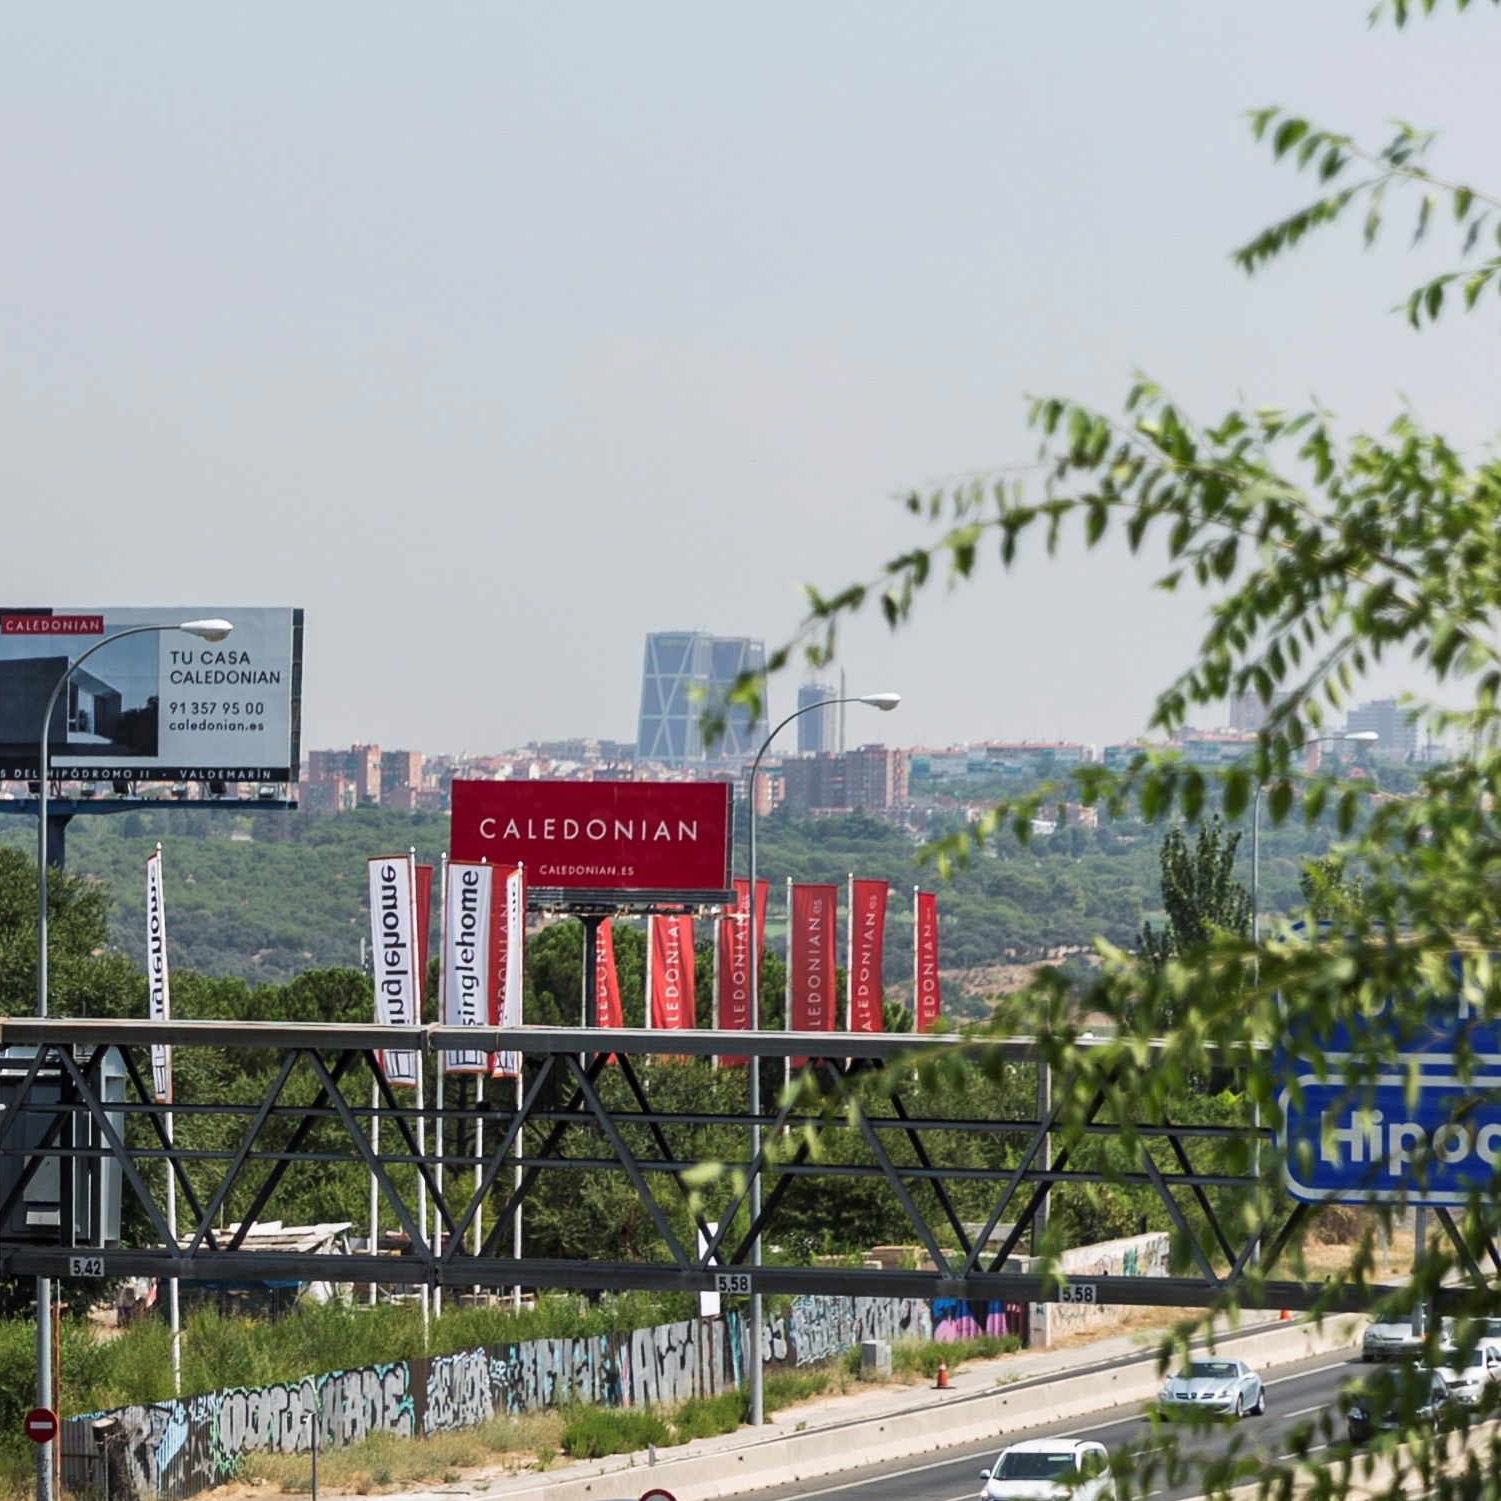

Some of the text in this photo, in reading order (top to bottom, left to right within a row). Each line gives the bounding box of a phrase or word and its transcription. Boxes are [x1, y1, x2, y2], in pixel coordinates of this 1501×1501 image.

[5, 619, 100, 631] CALEDONIAN
[170, 650, 251, 666] TU CASA
[170, 670, 281, 685] CALEDONIAN
[169, 701, 265, 715] 91 357 95 00
[169, 718, 265, 732] caledonian.es
[13, 769, 39, 779] DEL
[479, 817, 698, 842] CALEDONIAN
[539, 863, 635, 876] CALEDONIAN.ES
[73, 1259, 102, 1275] 5.42
[718, 1275, 749, 1292] 5.58
[1062, 1286, 1093, 1303] 5.58
